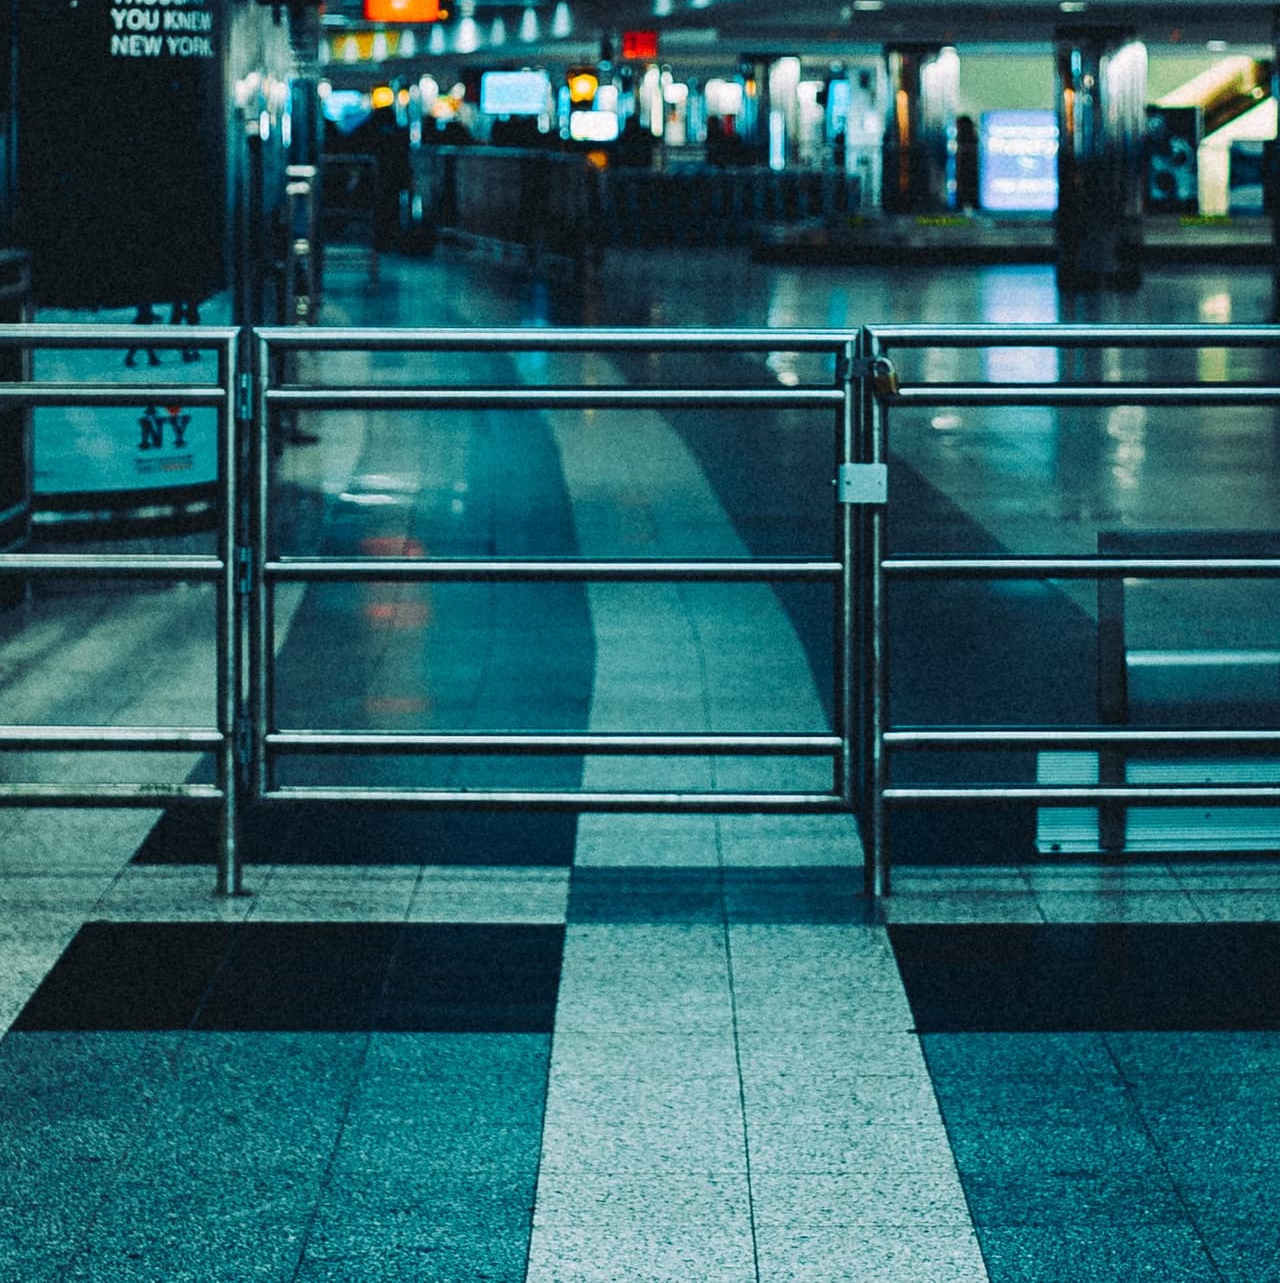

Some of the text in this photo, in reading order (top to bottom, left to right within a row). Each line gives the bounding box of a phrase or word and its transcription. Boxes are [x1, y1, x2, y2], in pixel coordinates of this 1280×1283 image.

[110, 7, 212, 31] YOU KNEW
[110, 34, 163, 57] NEW
[138, 415, 192, 449] NY
